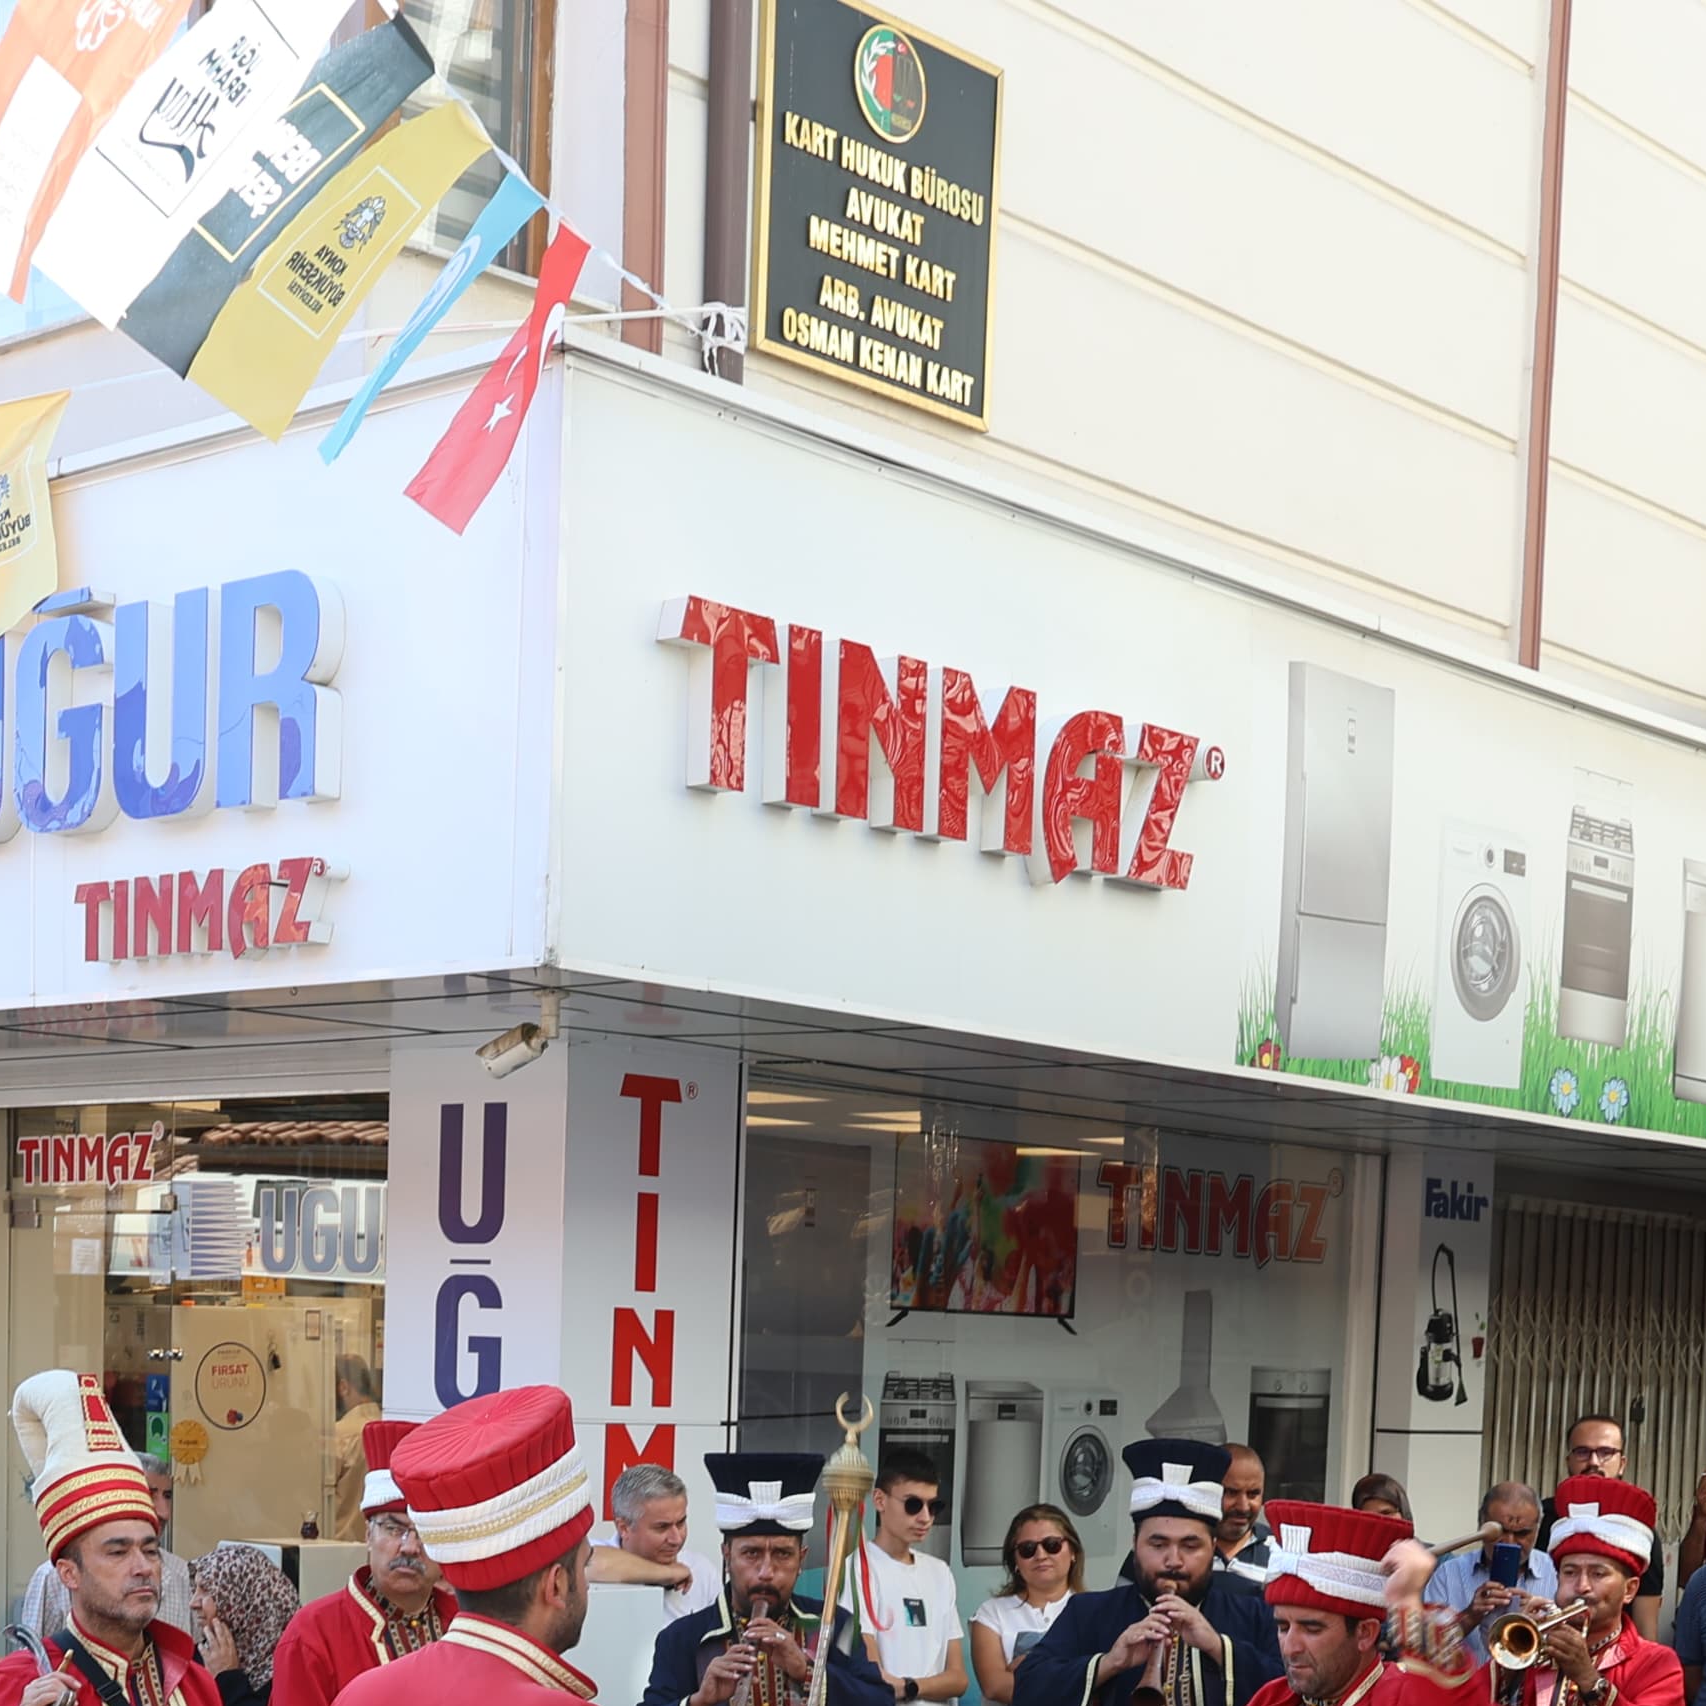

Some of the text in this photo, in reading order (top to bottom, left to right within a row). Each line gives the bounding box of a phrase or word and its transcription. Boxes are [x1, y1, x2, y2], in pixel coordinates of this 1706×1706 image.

[784, 111, 985, 226] KART HUKUK BÜROSU
[808, 215, 957, 303] MEHMET KART
[846, 187, 925, 247] AVUKAT
[782, 307, 975, 407] OSMAN KENAN KART
[819, 275, 945, 352] ARB. AVUKAT
[655, 594, 1200, 890] TINMAZ
[74, 856, 329, 963] TINMAZ
[16, 1131, 156, 1190] TINMAZ
[1425, 1177, 1490, 1224] Fakir
[257, 1177, 387, 1276] UĞU
[1096, 1156, 1331, 1268] TINMAZ
[211, 1363, 250, 1377] FIRSAT
